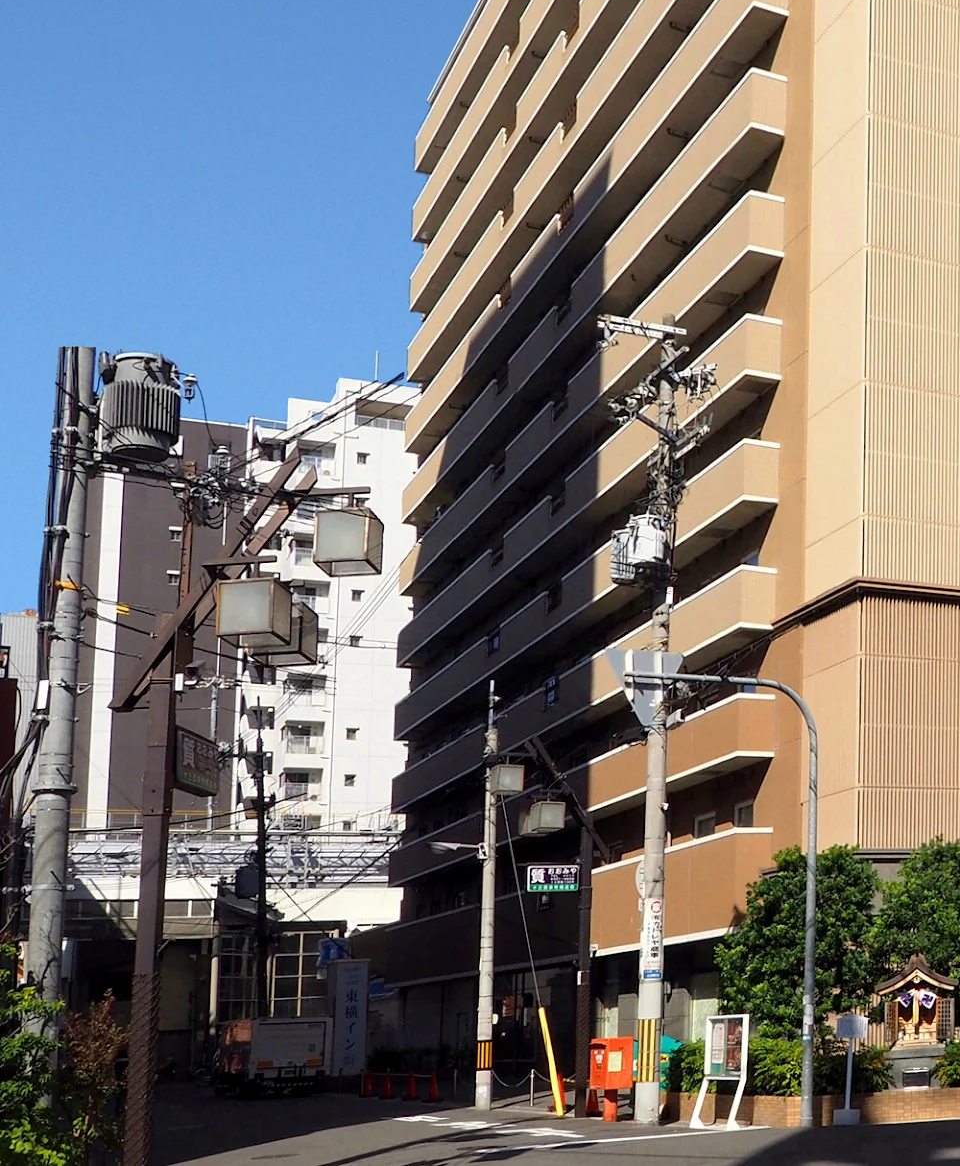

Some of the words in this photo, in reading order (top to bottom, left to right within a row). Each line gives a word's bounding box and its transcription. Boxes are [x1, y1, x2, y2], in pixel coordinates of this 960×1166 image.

[531, 868, 546, 884] 質
[345, 989, 359, 1050] 東横イン
